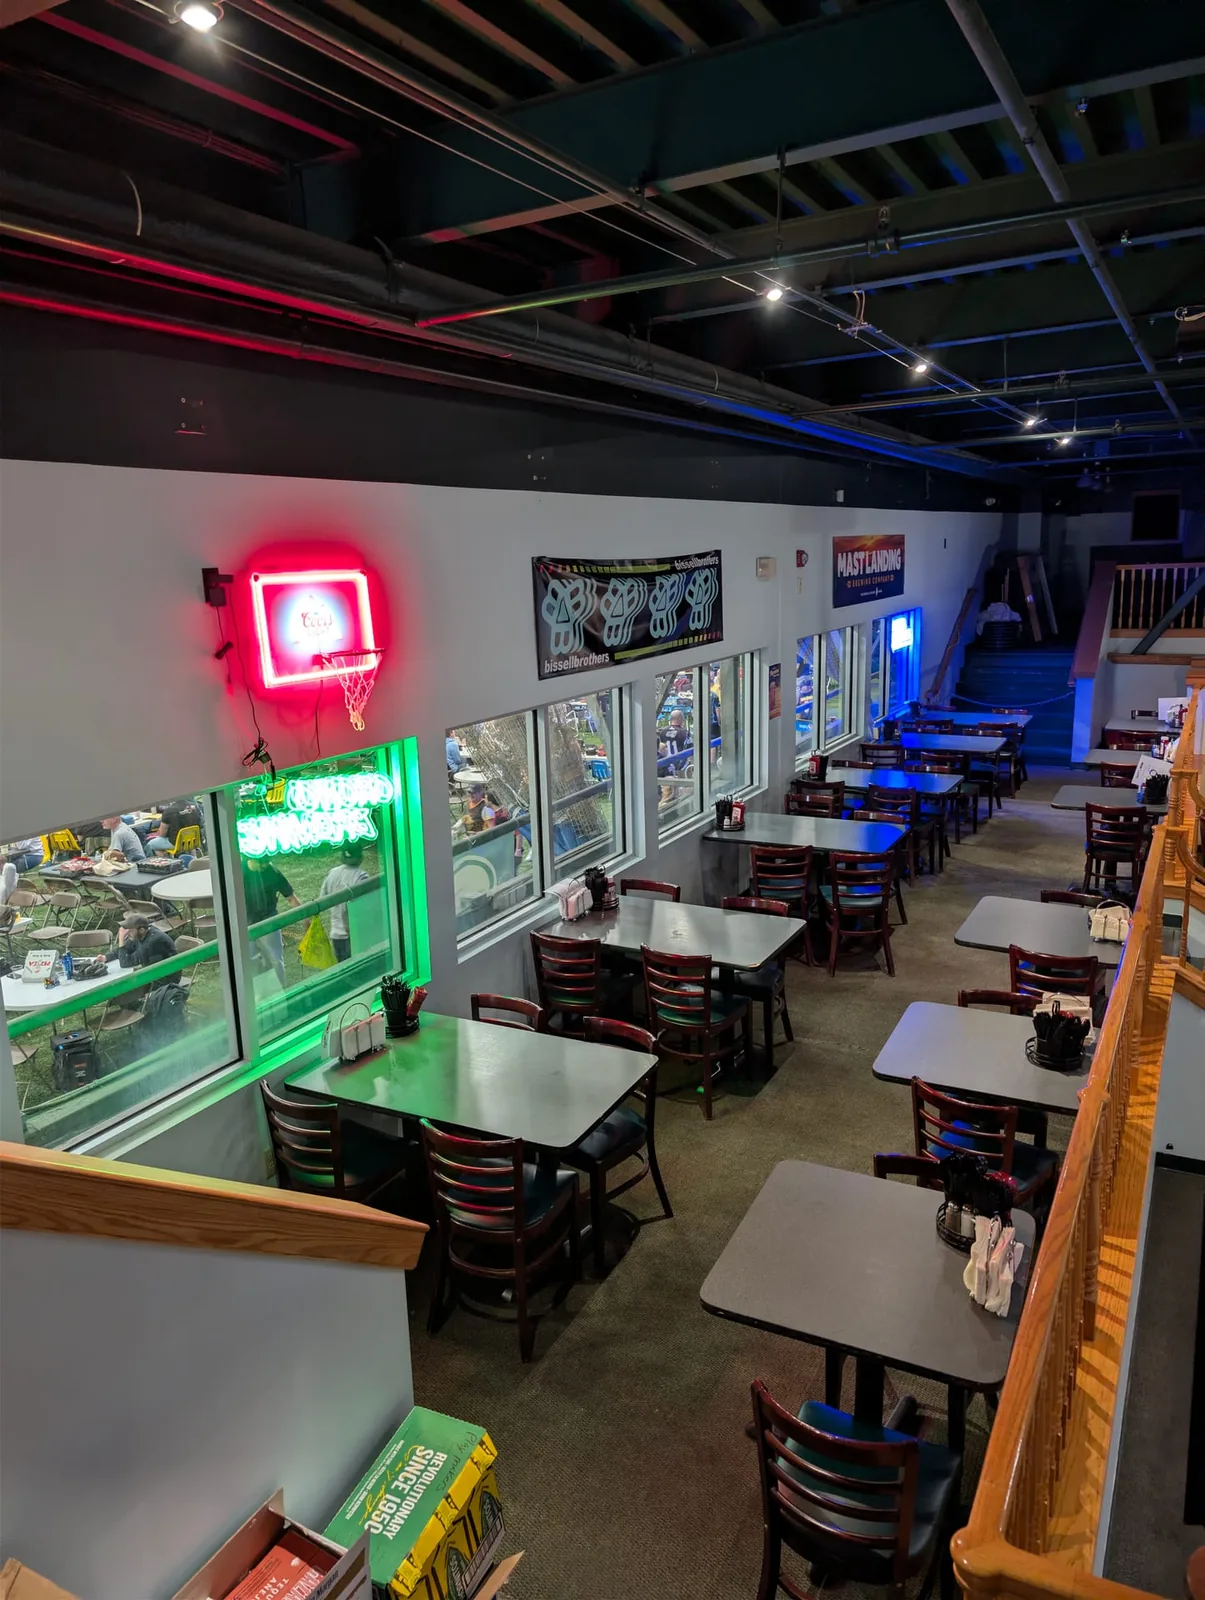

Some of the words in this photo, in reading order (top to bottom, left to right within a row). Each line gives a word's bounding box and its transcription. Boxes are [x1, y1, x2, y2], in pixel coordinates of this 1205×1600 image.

[837, 552, 864, 578] MAST
[865, 548, 902, 574] LANDING
[544, 652, 610, 673] bissellbrothers
[391, 1445, 434, 1494] SINCE
[364, 1493, 401, 1535] 1950
[383, 1452, 448, 1540] REVOLUTIONARY
